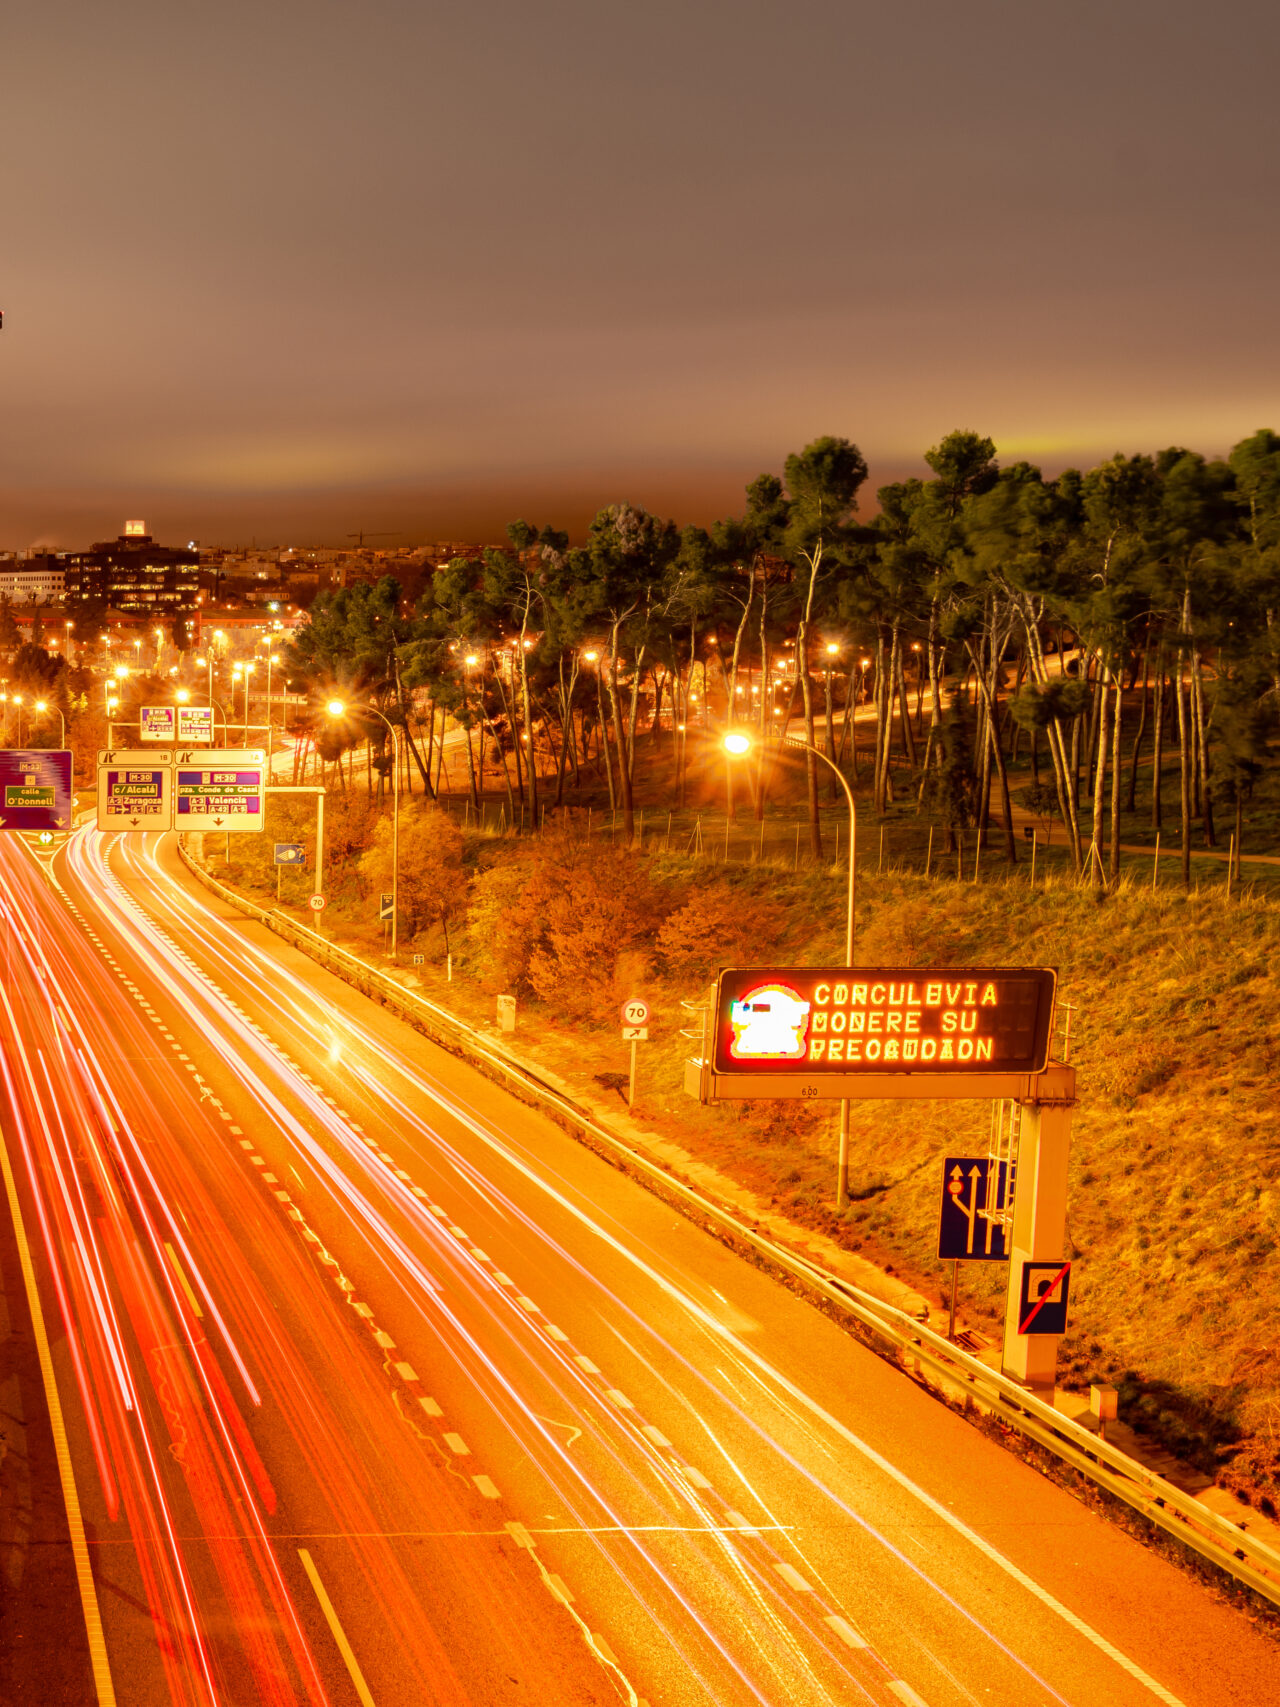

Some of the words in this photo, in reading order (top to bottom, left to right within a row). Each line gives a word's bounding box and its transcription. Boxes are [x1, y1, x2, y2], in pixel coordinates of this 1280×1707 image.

[7, 797, 54, 805] O'Donnell
[123, 797, 162, 806] Zaragoza
[209, 796, 247, 804] Valencia
[628, 1008, 645, 1018] 70
[941, 1010, 978, 1032] SU
